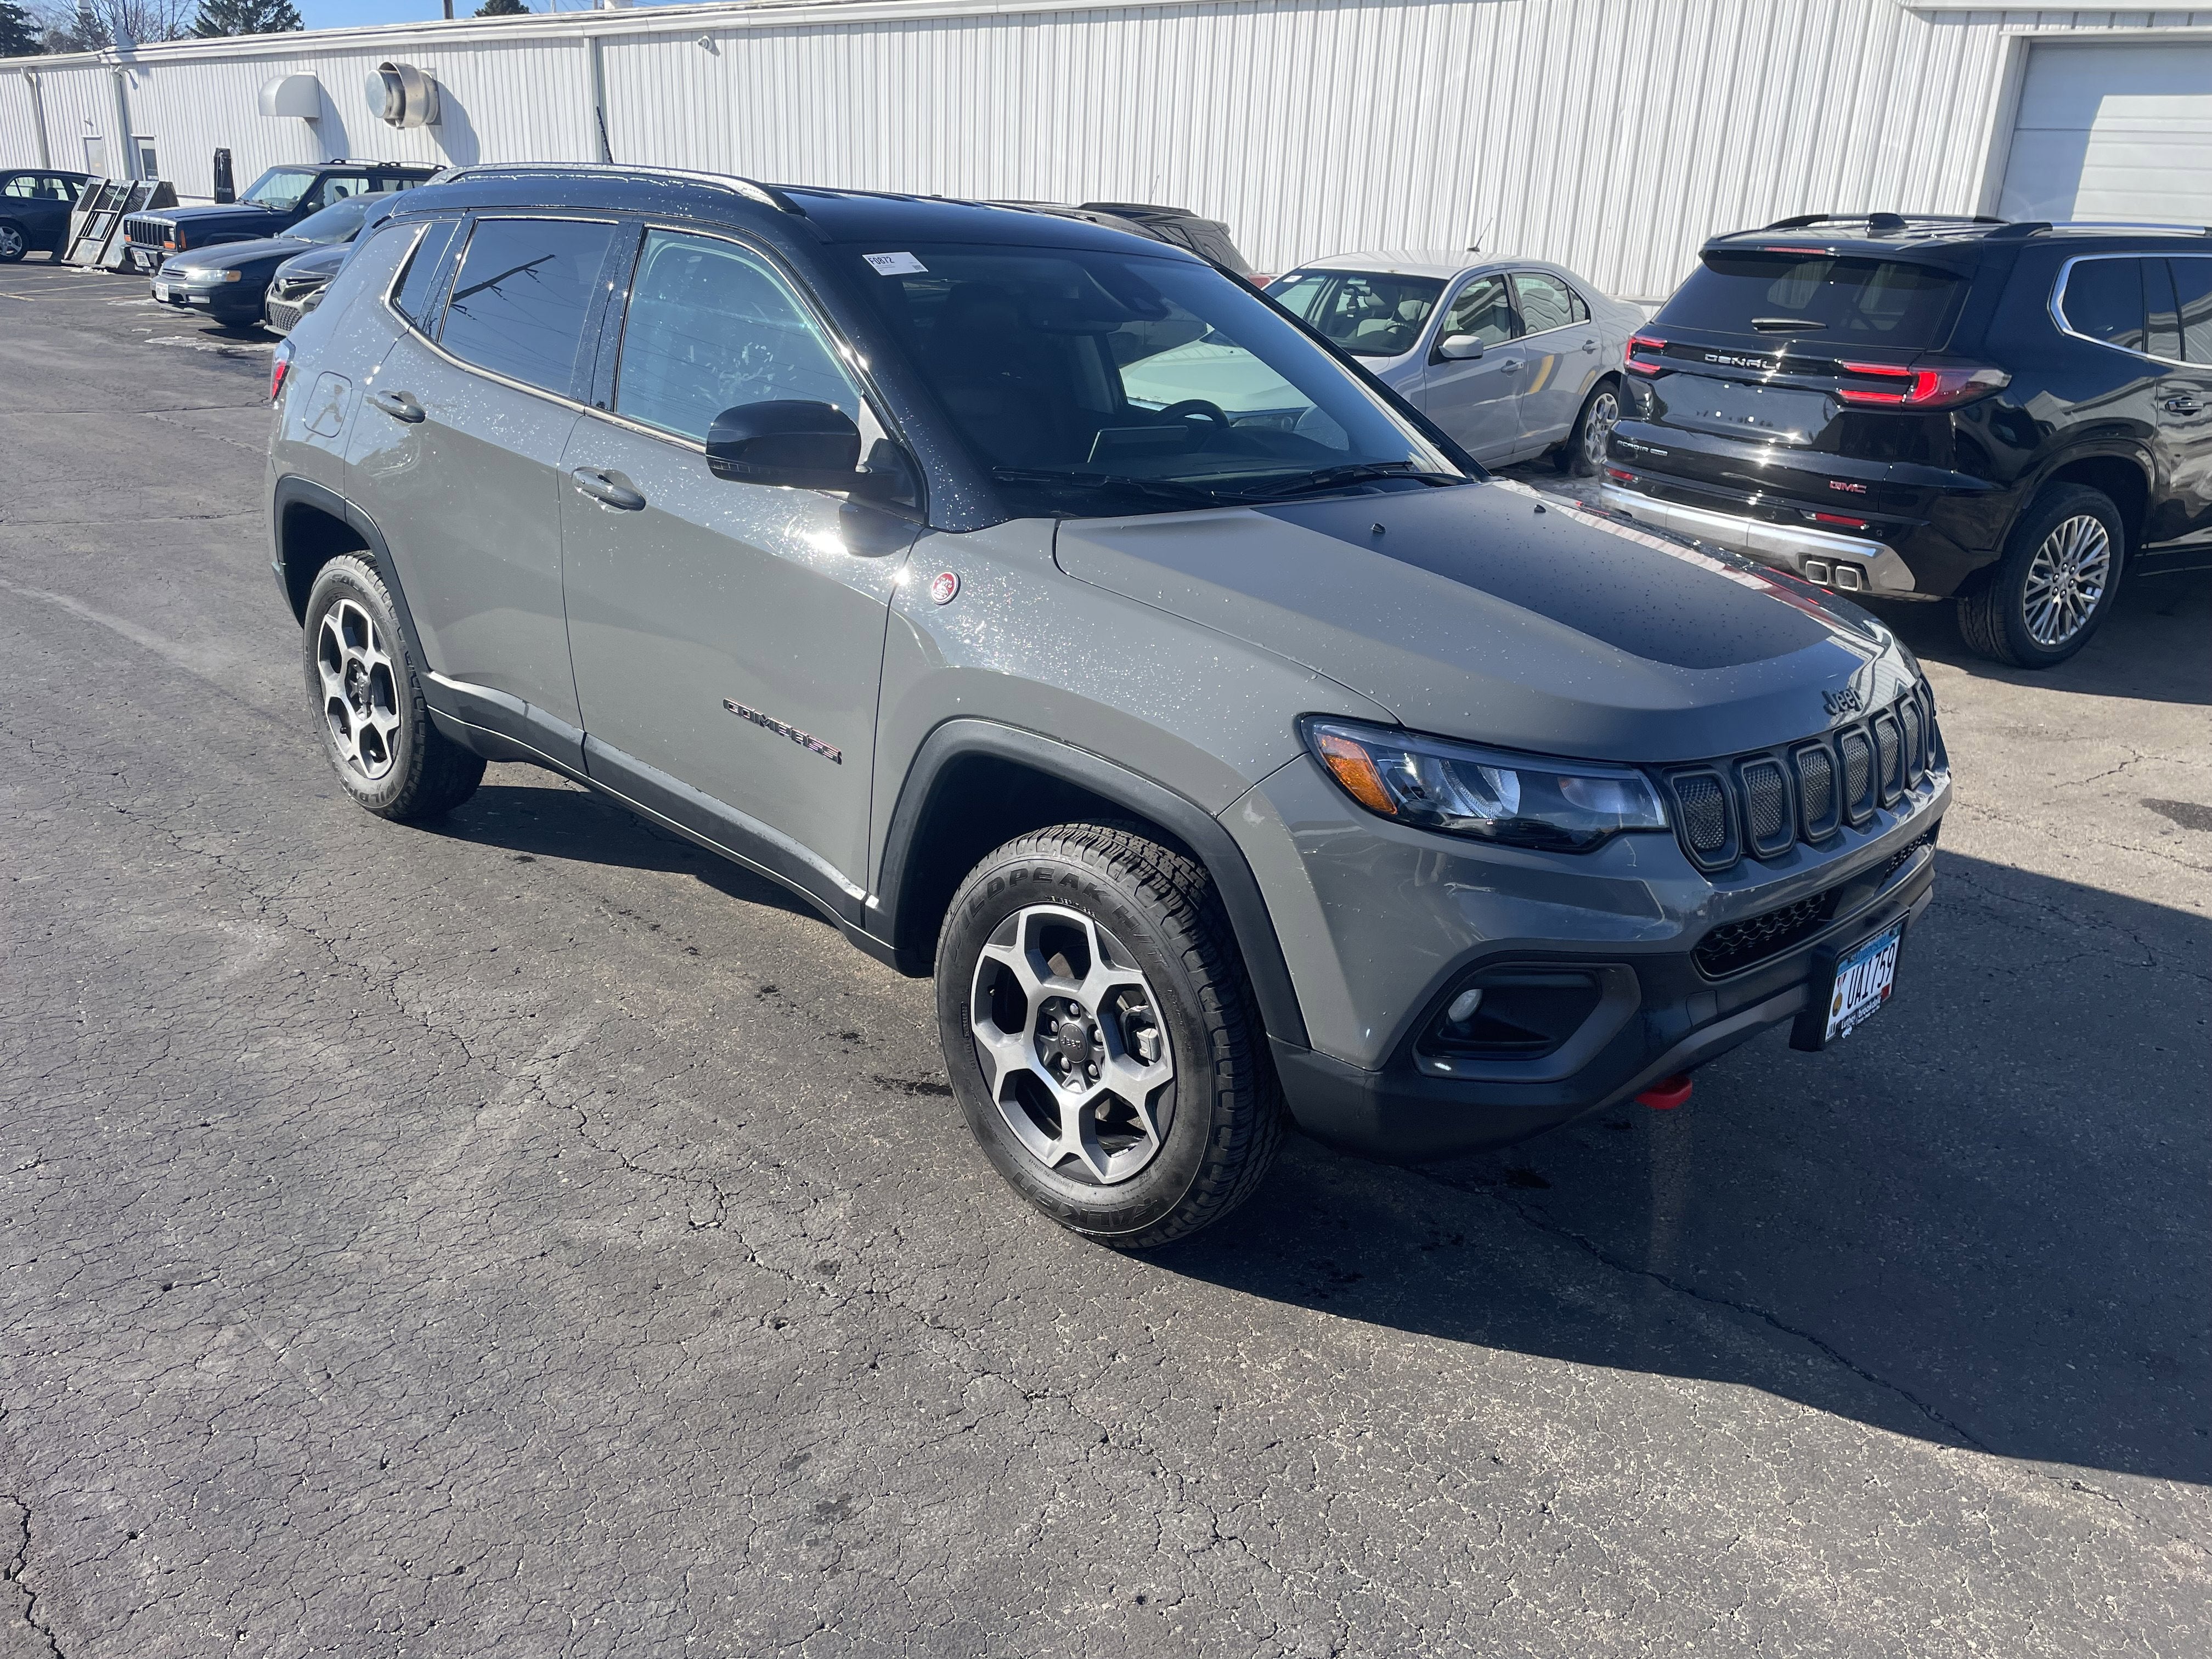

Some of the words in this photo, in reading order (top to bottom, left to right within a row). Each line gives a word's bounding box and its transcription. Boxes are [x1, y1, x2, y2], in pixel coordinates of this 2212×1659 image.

[1705, 353, 1781, 370] DENALI
[1829, 481, 1867, 494] GMC
[1821, 686, 1864, 715] Jeep
[723, 697, 842, 765] COMPASS
[947, 867, 1111, 963] WILDPEAK
[1112, 905, 1169, 968] H/T
[1847, 943, 1895, 1009] UA1759
[1060, 1035, 1083, 1051] Jeep
